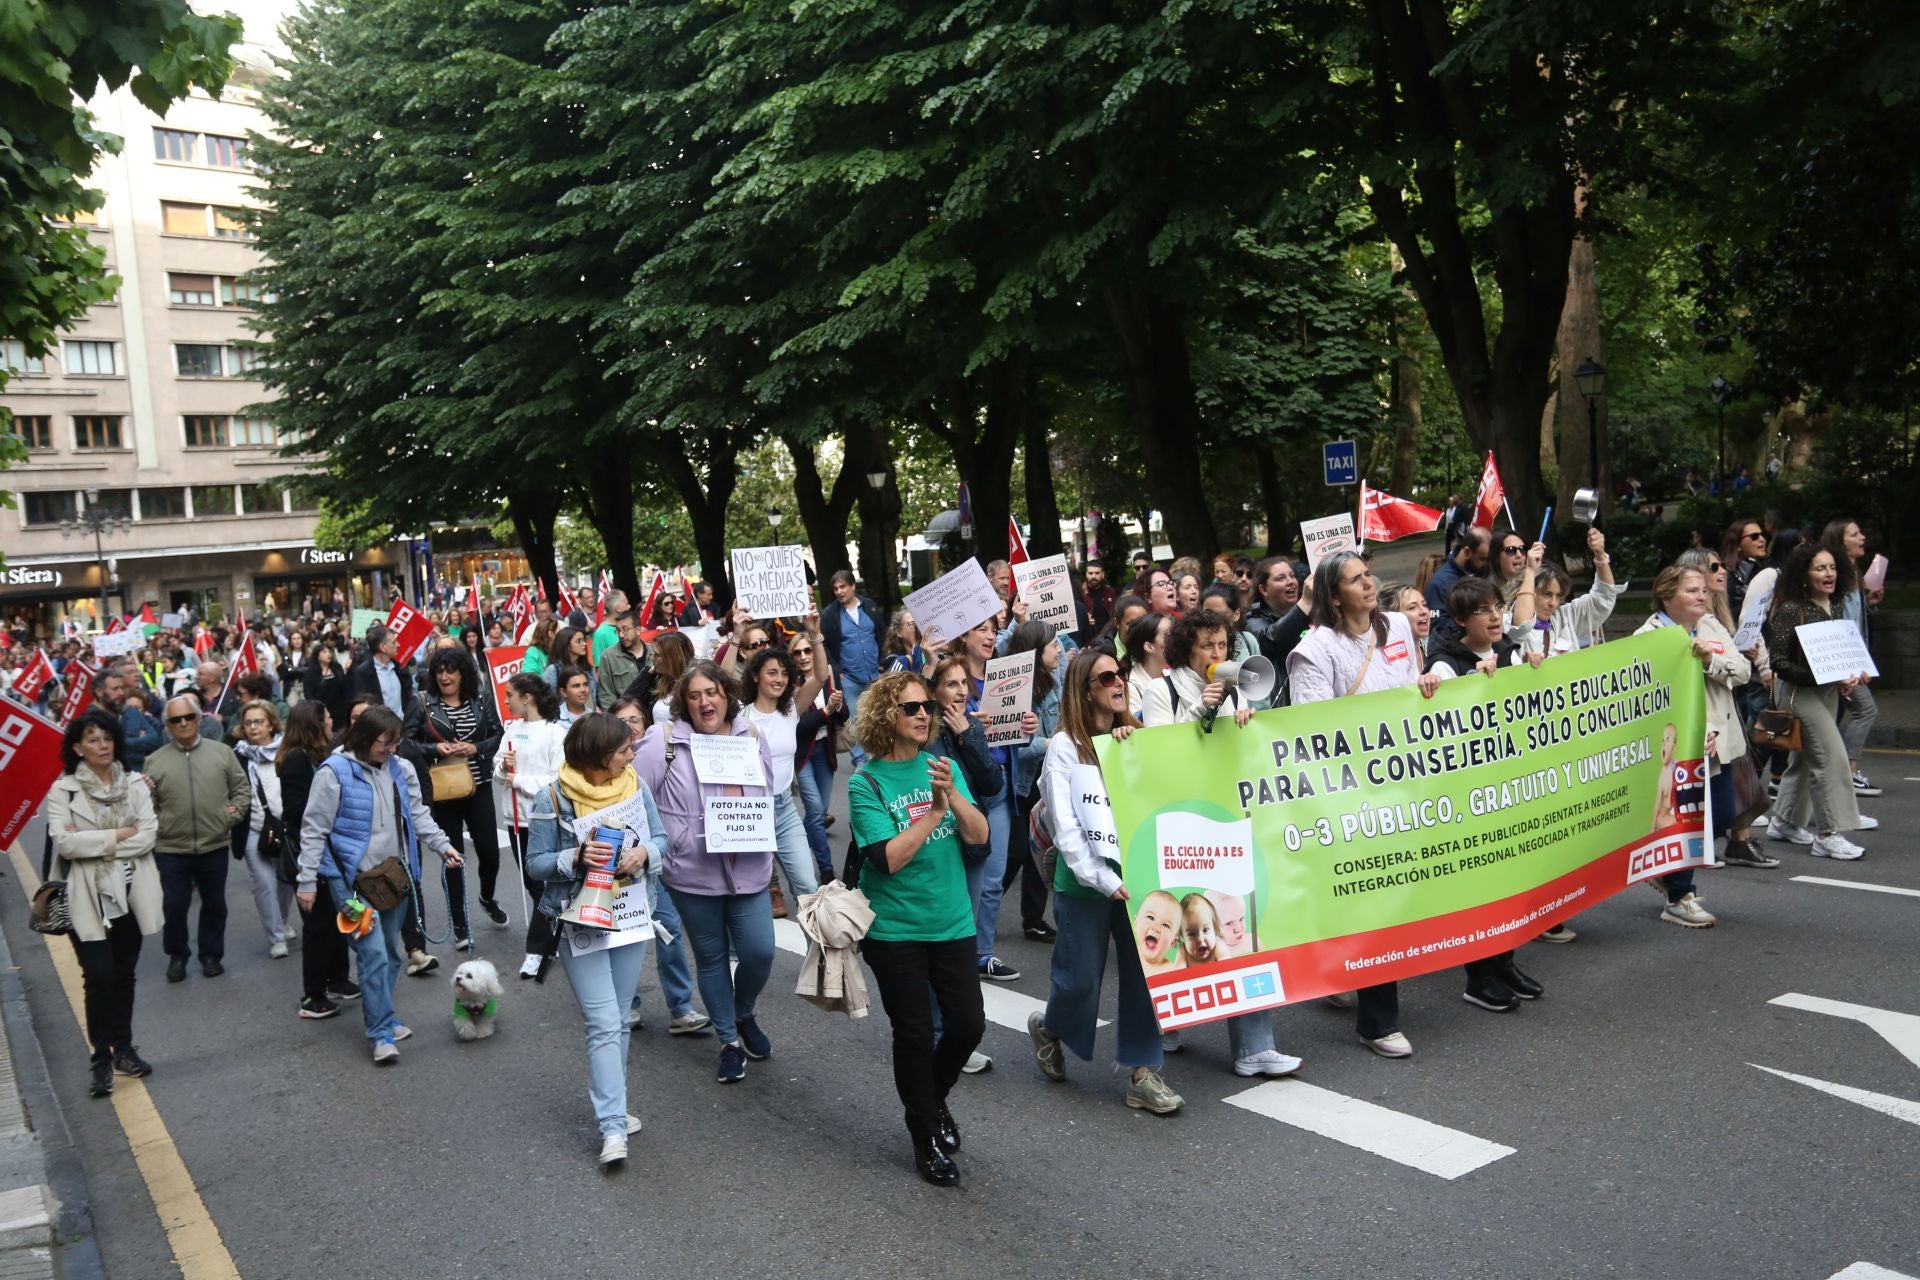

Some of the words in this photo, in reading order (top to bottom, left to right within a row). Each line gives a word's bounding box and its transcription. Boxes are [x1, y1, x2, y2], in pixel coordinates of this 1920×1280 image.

[1327, 455, 1353, 470] TAXI
[1305, 533, 1316, 542] NO
[1317, 531, 1325, 540] ES
[1326, 528, 1340, 538] UNA
[1340, 525, 1352, 534] RED
[733, 551, 754, 572] NO
[739, 573, 756, 590] LAS
[759, 570, 804, 591] MEDIAS
[1017, 574, 1028, 583] NO
[1028, 571, 1037, 581] ES
[1037, 567, 1052, 578] UNA
[1052, 564, 1066, 574] RED
[741, 591, 806, 614] JORNADAS
[1040, 591, 1054, 603] SIN
[1029, 604, 1069, 621] IGUALDAD
[986, 671, 997, 682] NO
[998, 669, 1007, 680] ES
[1007, 666, 1021, 677] UNA
[1021, 663, 1033, 674] RED
[1001, 695, 1016, 707] SIN
[1272, 729, 1352, 768] PARA
[1358, 722, 1396, 753] LA
[1402, 701, 1499, 745] LOMLOE
[1503, 685, 1566, 724] SOMOS
[1569, 655, 1652, 708] EDUCACIÓN
[1237, 769, 1316, 809] PARA
[1320, 762, 1359, 795] LA
[1365, 725, 1523, 786] CONSEJERÍA,
[1526, 714, 1572, 751] SÓLO
[1576, 681, 1672, 738] CONCILIACIÓN
[1283, 816, 1335, 852] 0-3
[1340, 794, 1464, 843] PÚBLICO,
[1468, 769, 1559, 817] GRATUITO
[1560, 761, 1574, 789] Y
[1576, 734, 1653, 784] UNIVERSAL
[1, 799, 32, 839] ASTURIAS
[717, 813, 763, 821] CONTRATO
[1333, 850, 1418, 876] CONSEJERA:
[1420, 841, 1461, 860] BASTA
[1464, 834, 1479, 849] DE
[1481, 817, 1540, 845] PUBLICIDAD
[1541, 804, 1583, 829] ¡SIENTATE
[1584, 802, 1590, 813] A
[1590, 784, 1629, 810] NEGOCIAR!
[1163, 845, 1175, 857] EL
[1177, 844, 1205, 858] CICLO
[1206, 845, 1213, 857] 0
[1214, 845, 1222, 857] A
[1222, 845, 1229, 857] 3
[1231, 844, 1244, 857] ES
[1332, 867, 1430, 897] INTEGRACIÓN
[1433, 860, 1456, 878] DEL
[1459, 847, 1517, 872] PERSONAL
[1518, 828, 1570, 854] NEGOCIADA
[1570, 824, 1577, 836] Y
[1577, 802, 1630, 834] TRANSPARENTE
[1631, 841, 1684, 875] CCOO
[1164, 858, 1215, 870] EDUCATIVO
[1344, 949, 1405, 972] federación
[1406, 945, 1420, 958] de
[1421, 934, 1467, 954] servicios
[1468, 934, 1475, 943] a
[1476, 929, 1486, 941] la
[1486, 913, 1529, 938] ciudadanía
[1529, 910, 1538, 922] de
[1538, 902, 1556, 917] CCOO
[1556, 897, 1563, 908] de
[1563, 886, 1586, 904] Asturias
[1152, 979, 1239, 1020] CCOO
